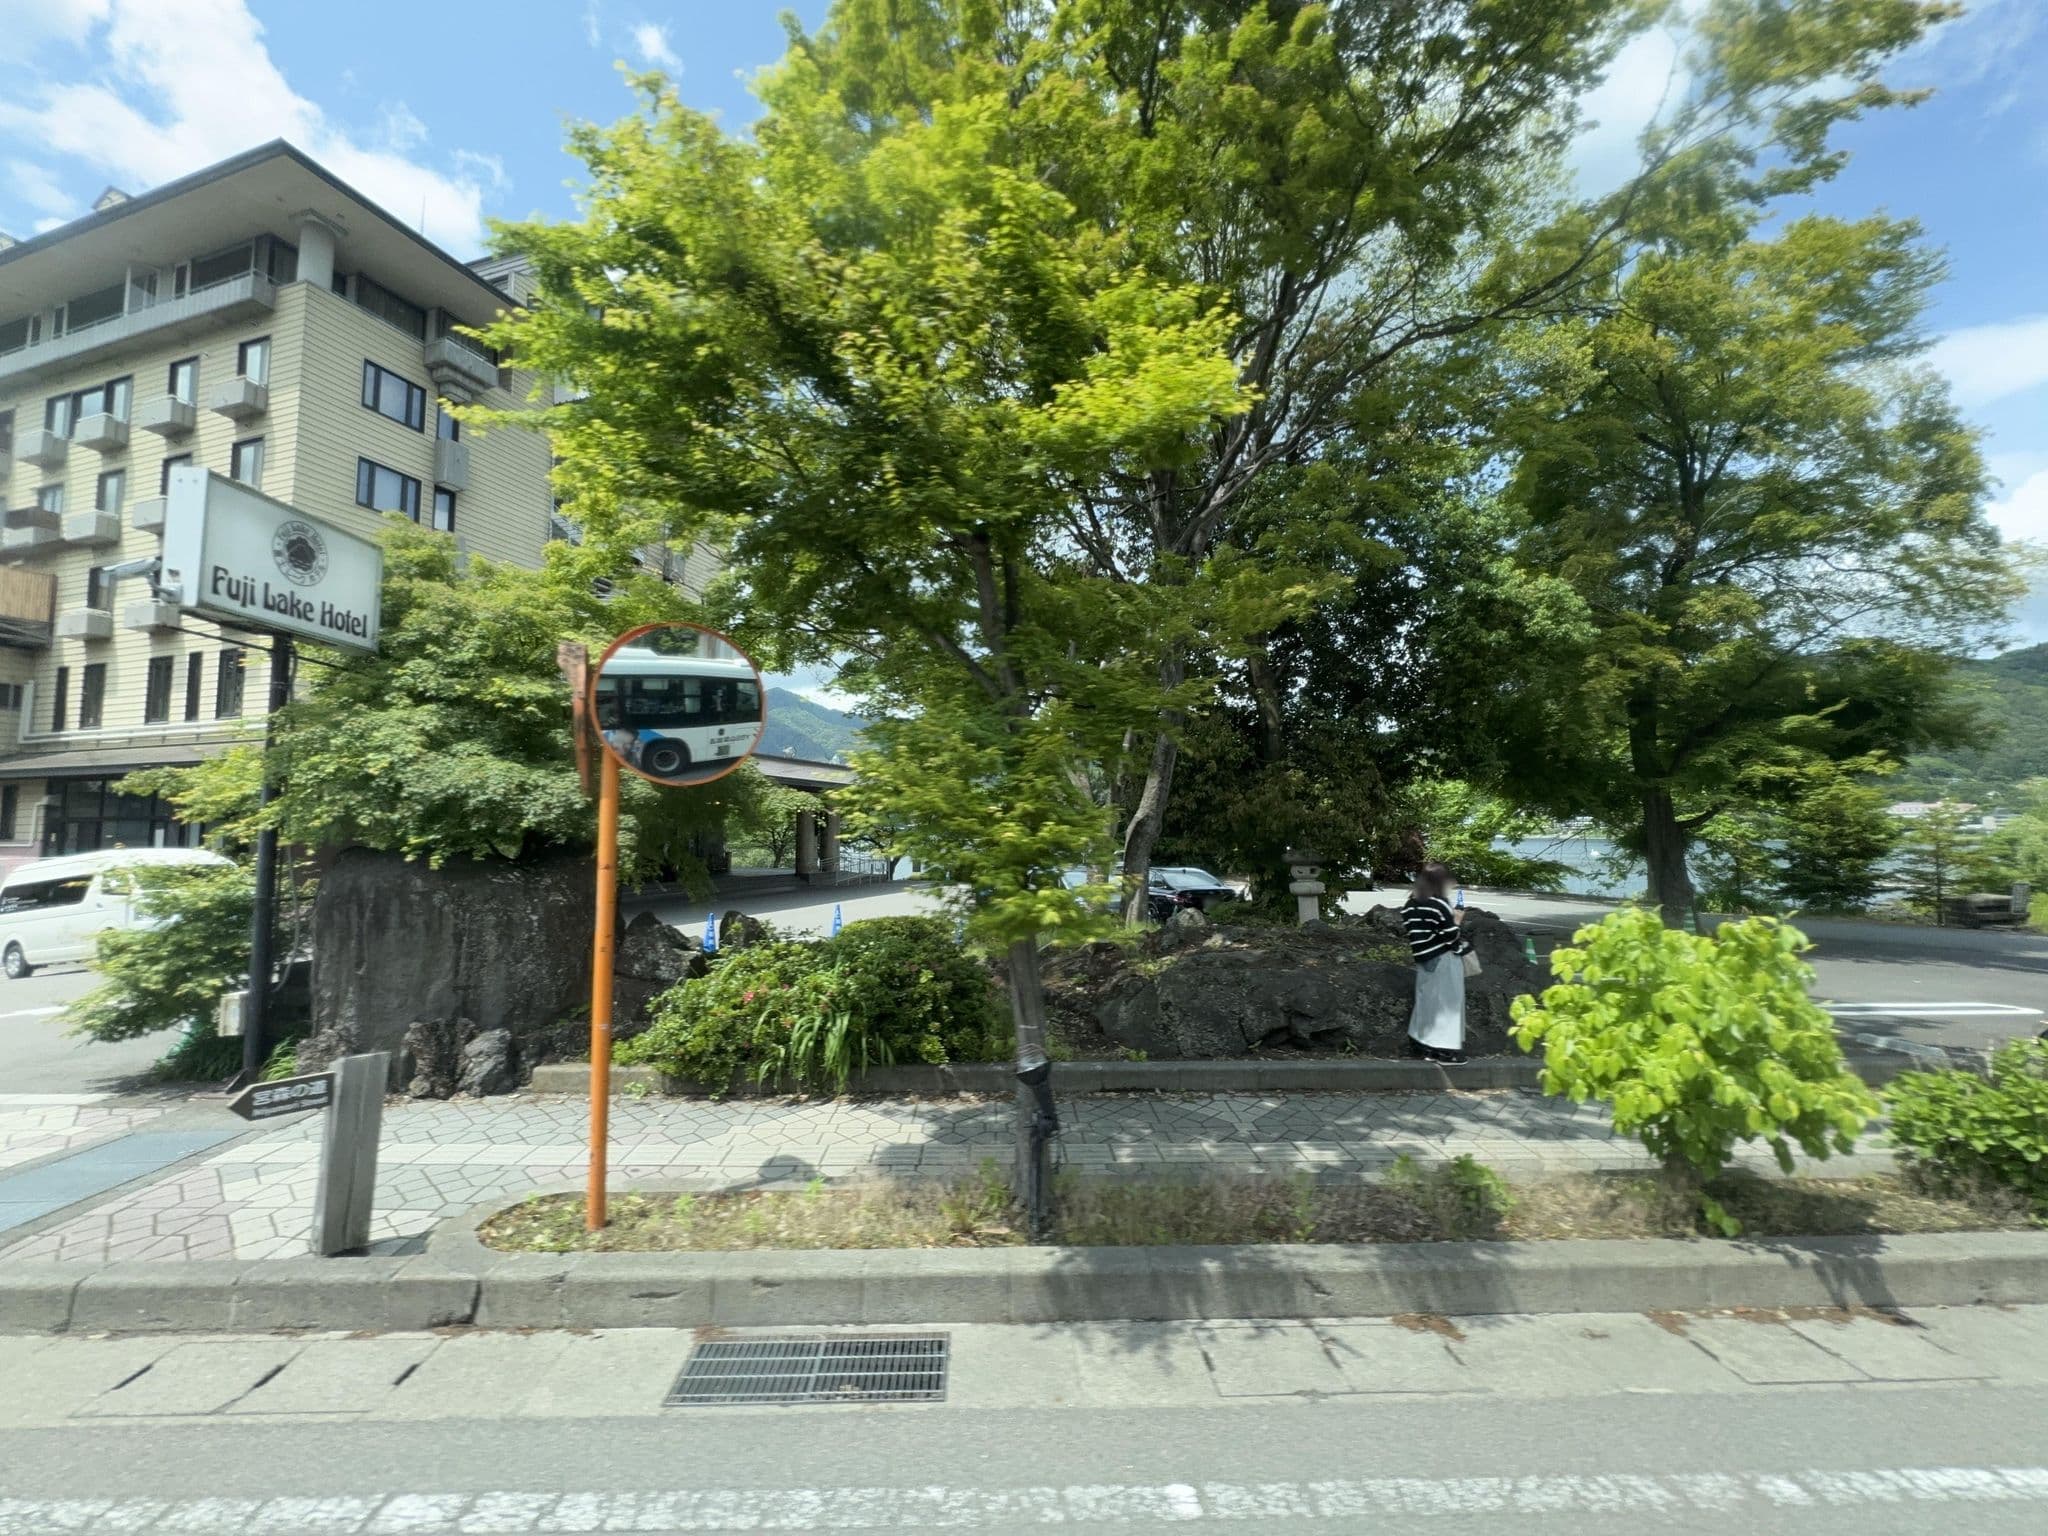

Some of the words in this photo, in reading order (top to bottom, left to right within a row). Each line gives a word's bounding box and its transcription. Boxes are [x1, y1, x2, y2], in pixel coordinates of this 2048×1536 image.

[212, 565, 256, 608] Fuji
[263, 582, 315, 622] Lake
[320, 601, 367, 638] Hotel
